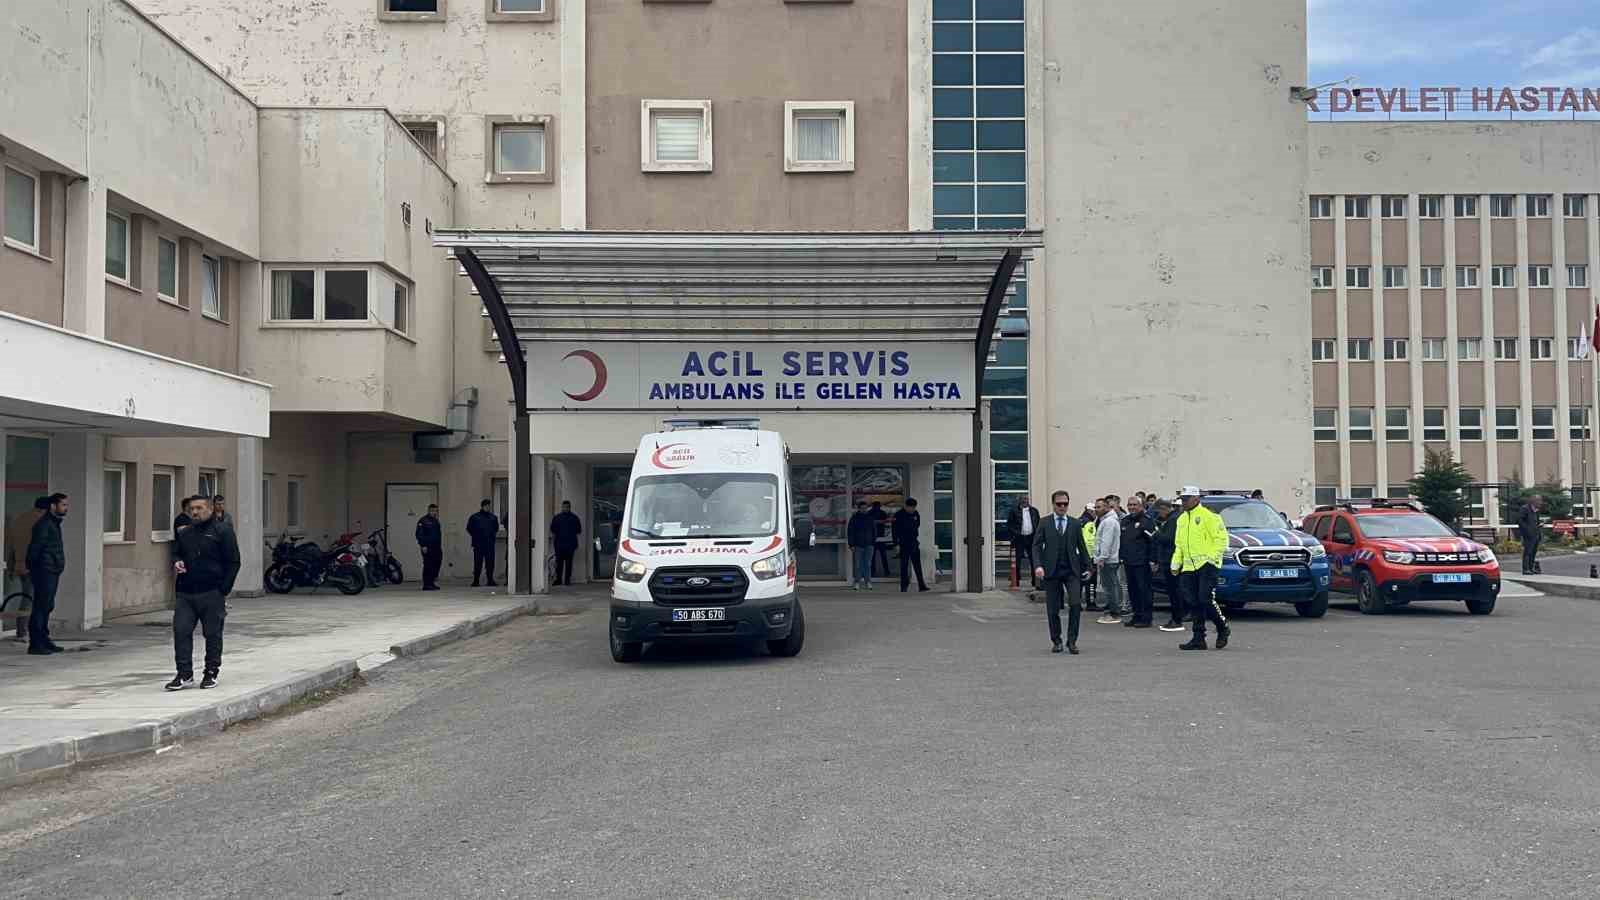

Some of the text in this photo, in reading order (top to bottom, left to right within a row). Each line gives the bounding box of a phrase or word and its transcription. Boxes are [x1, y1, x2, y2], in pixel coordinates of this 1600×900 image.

[1330, 87, 1461, 112] DEVLET
[1471, 87, 1600, 112] HASTAN
[649, 383, 764, 400] AMBULANS
[816, 383, 882, 400] GELEN
[893, 383, 961, 400] HASTA
[678, 609, 723, 620] 50 ABS 670
